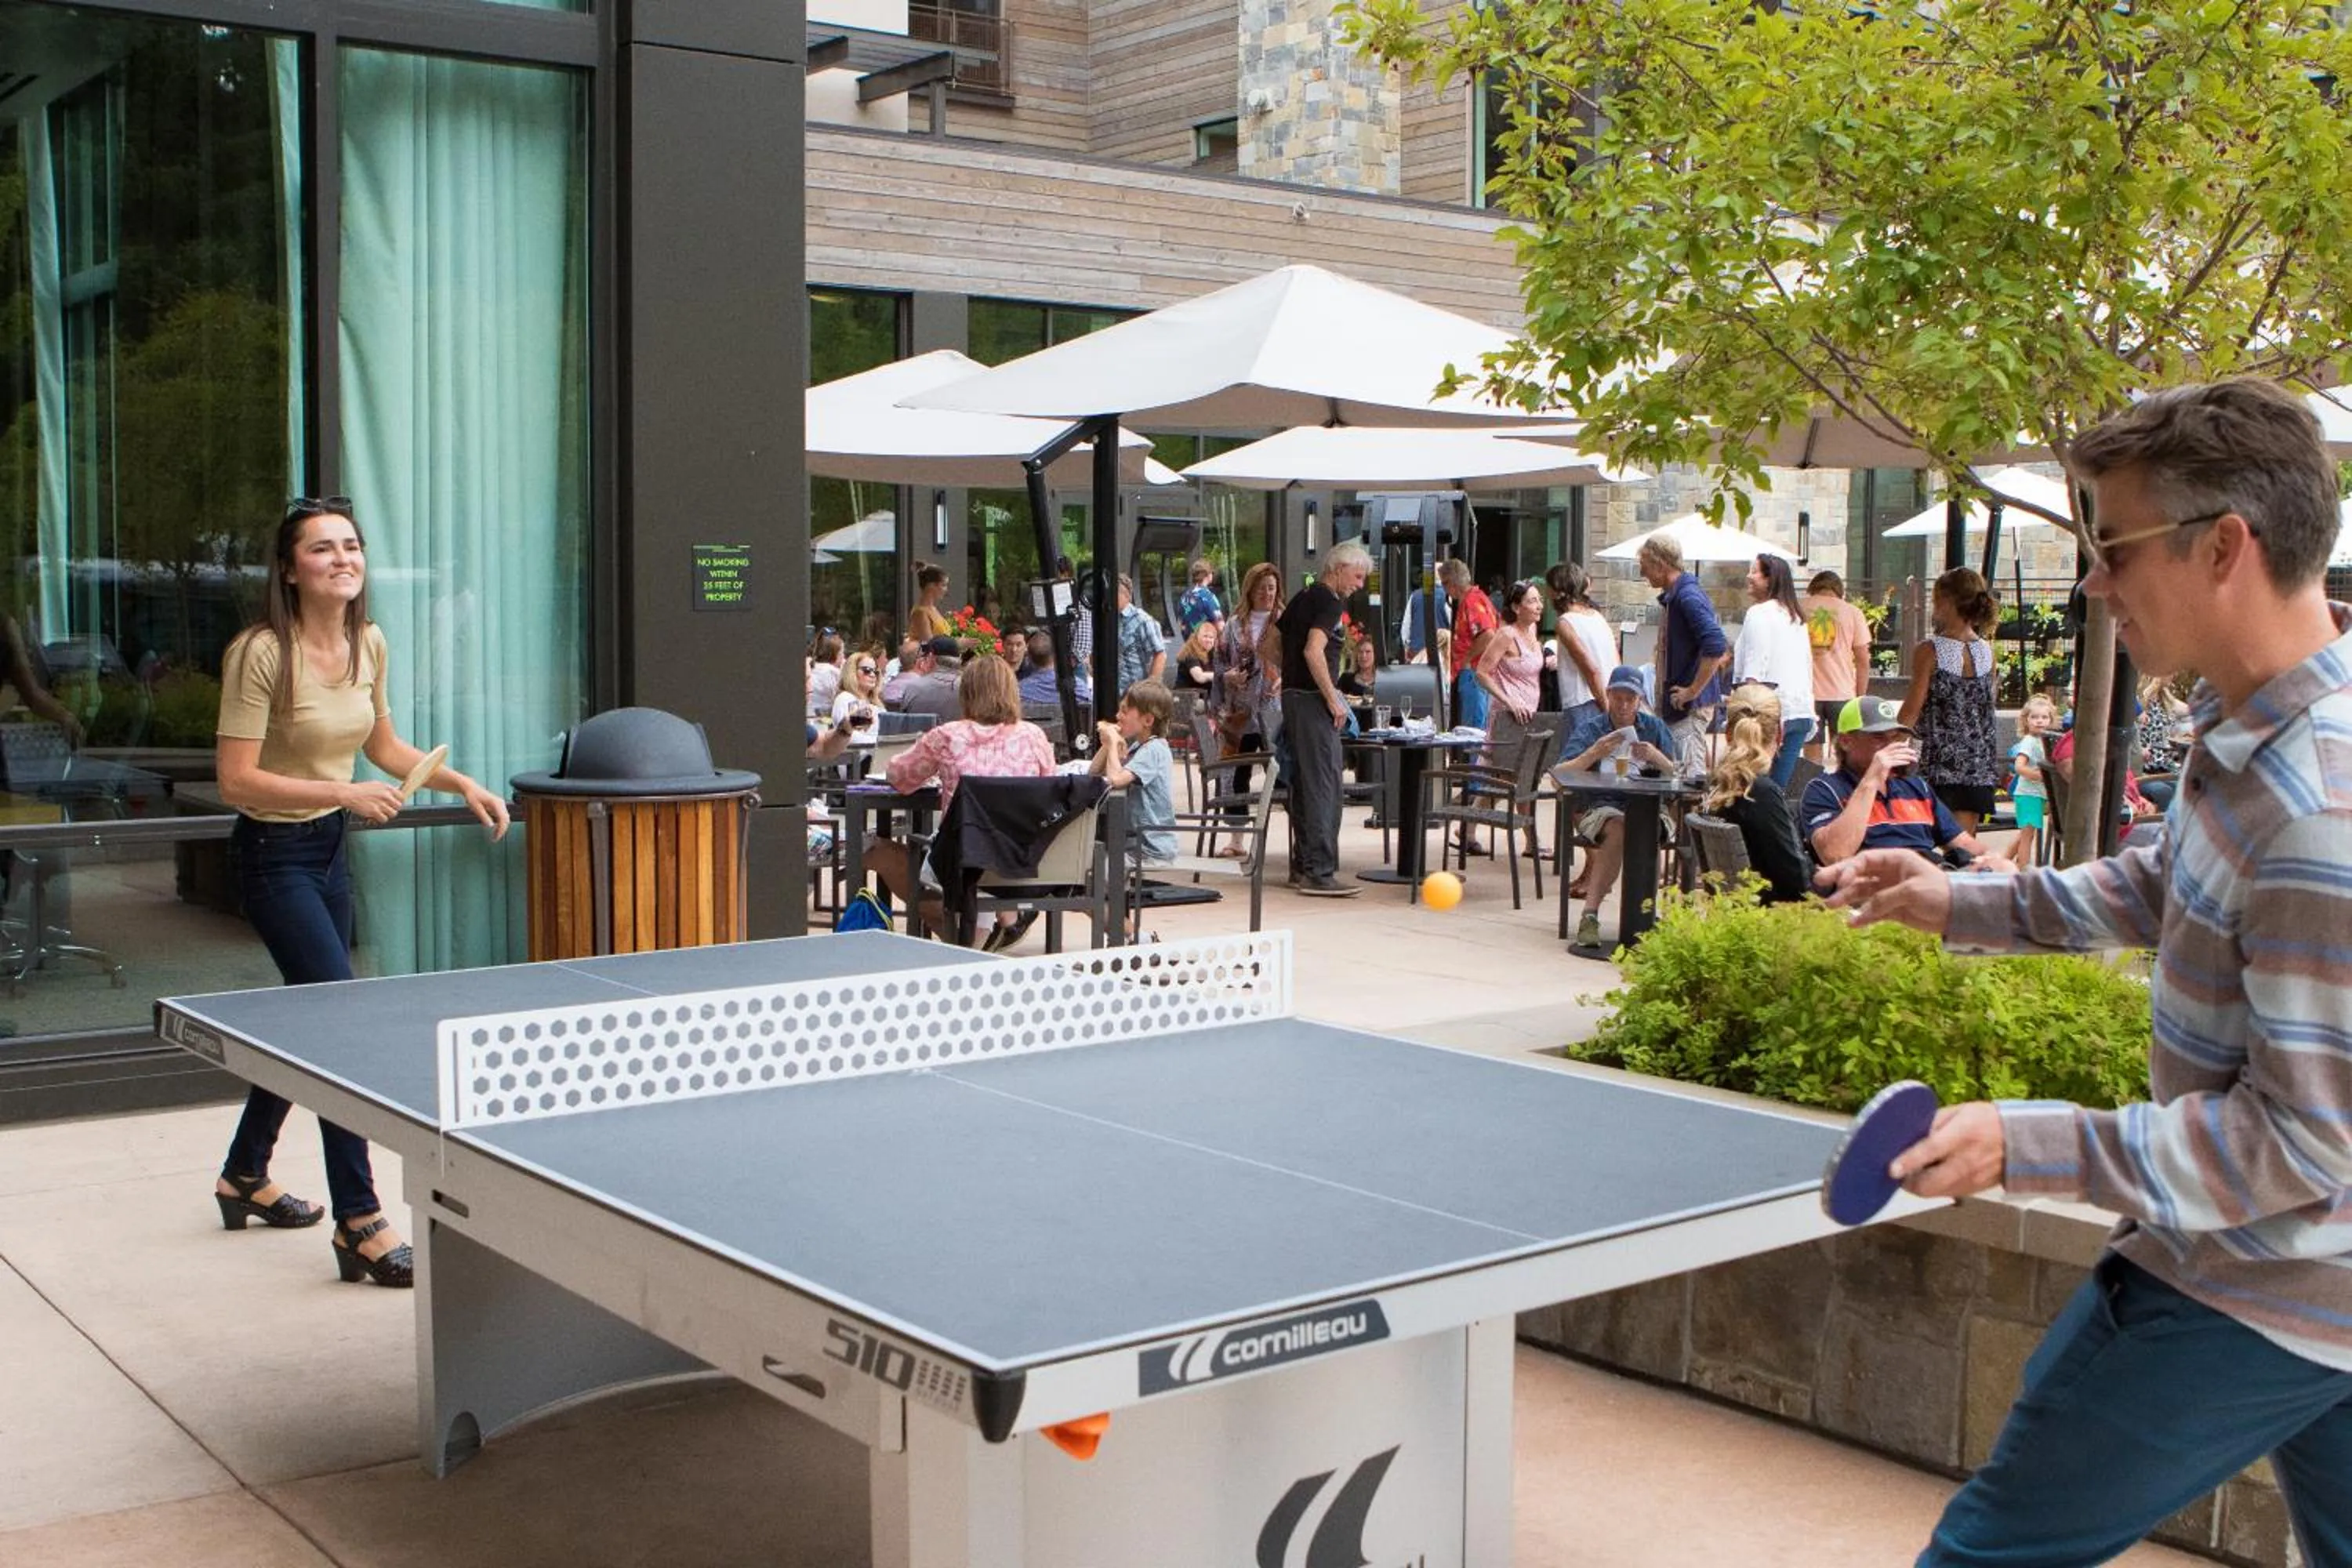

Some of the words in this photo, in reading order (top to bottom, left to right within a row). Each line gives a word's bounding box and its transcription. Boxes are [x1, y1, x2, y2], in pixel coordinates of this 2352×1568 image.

[697, 557, 711, 566] NO
[713, 557, 749, 566] SMOKING
[1222, 1312, 1367, 1366] cornilleau
